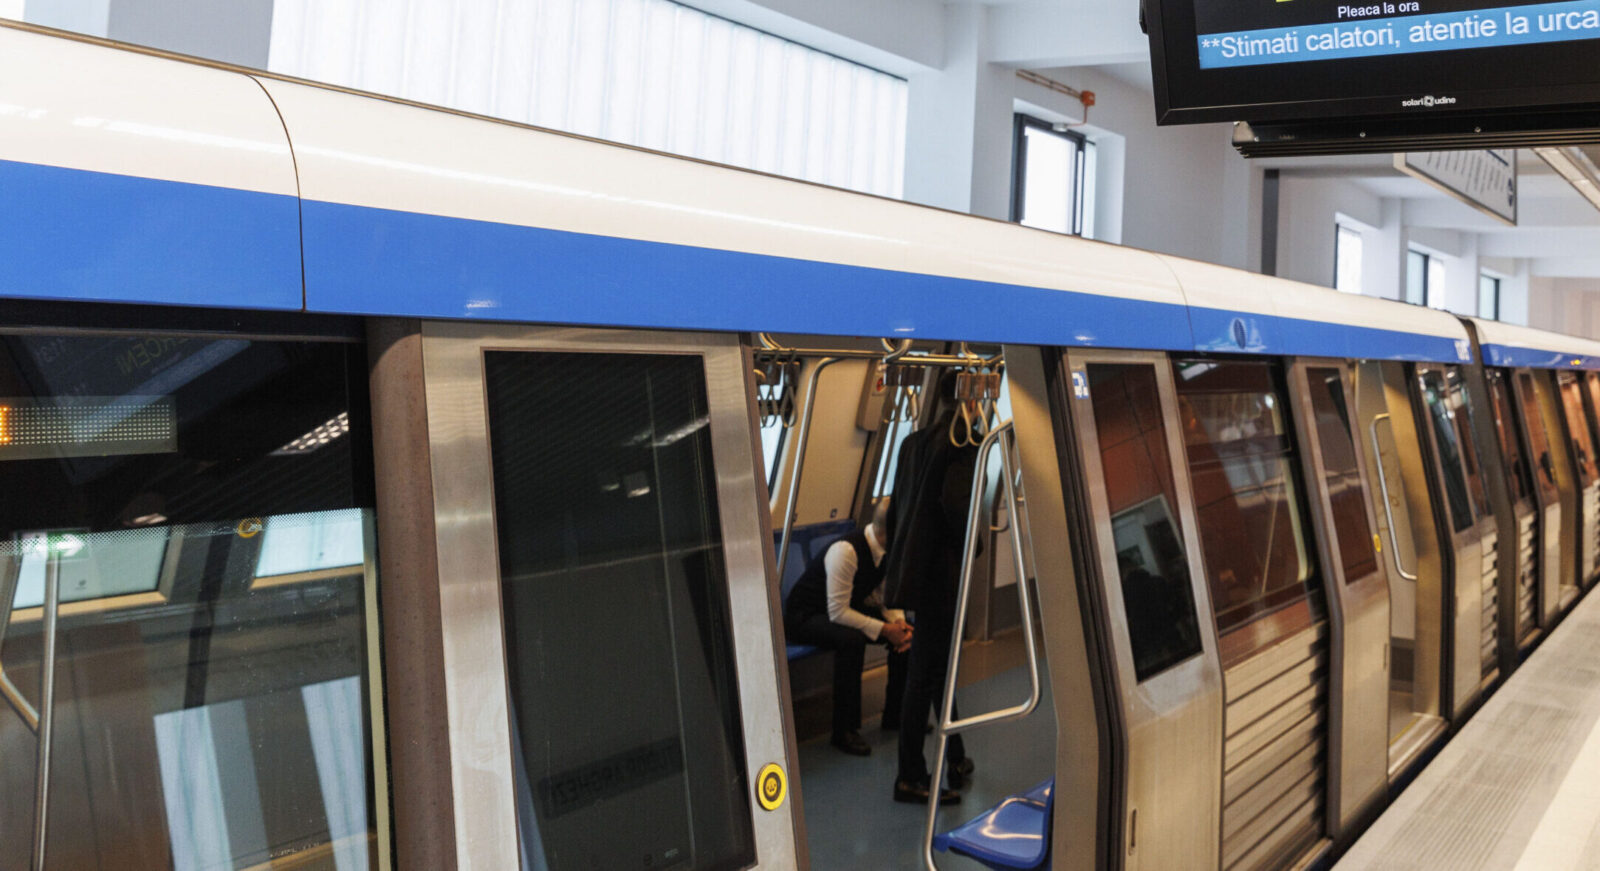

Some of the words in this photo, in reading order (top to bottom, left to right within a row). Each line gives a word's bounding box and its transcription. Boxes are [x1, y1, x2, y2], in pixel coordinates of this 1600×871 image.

[1337, 4, 1381, 18] Pleaca
[1383, 2, 1396, 14] la
[1398, 1, 1420, 13] ora
[1305, 23, 1400, 51] calatori,
[1409, 15, 1498, 43] atentie
[1505, 12, 1530, 35] la
[1401, 98, 1424, 107] solari
[1434, 96, 1457, 105] udine
